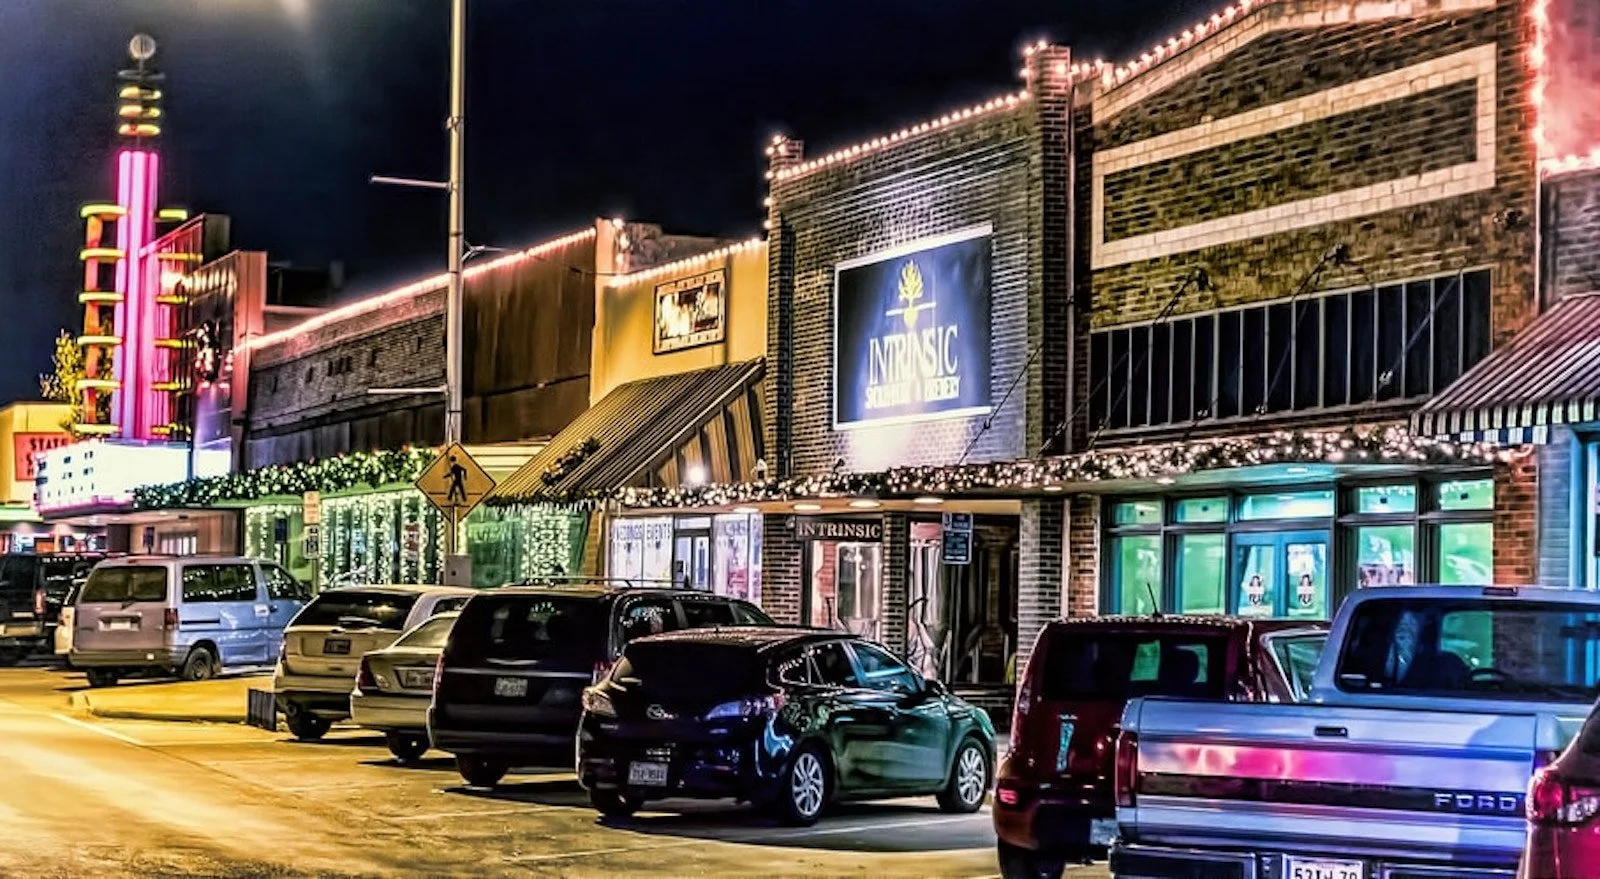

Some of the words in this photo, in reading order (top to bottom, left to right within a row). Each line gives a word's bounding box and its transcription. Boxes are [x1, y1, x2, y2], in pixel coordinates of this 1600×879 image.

[869, 324, 958, 386] INTRINSIC
[798, 522, 881, 539] INTRINSIC
[1434, 793, 1517, 811] FORD
